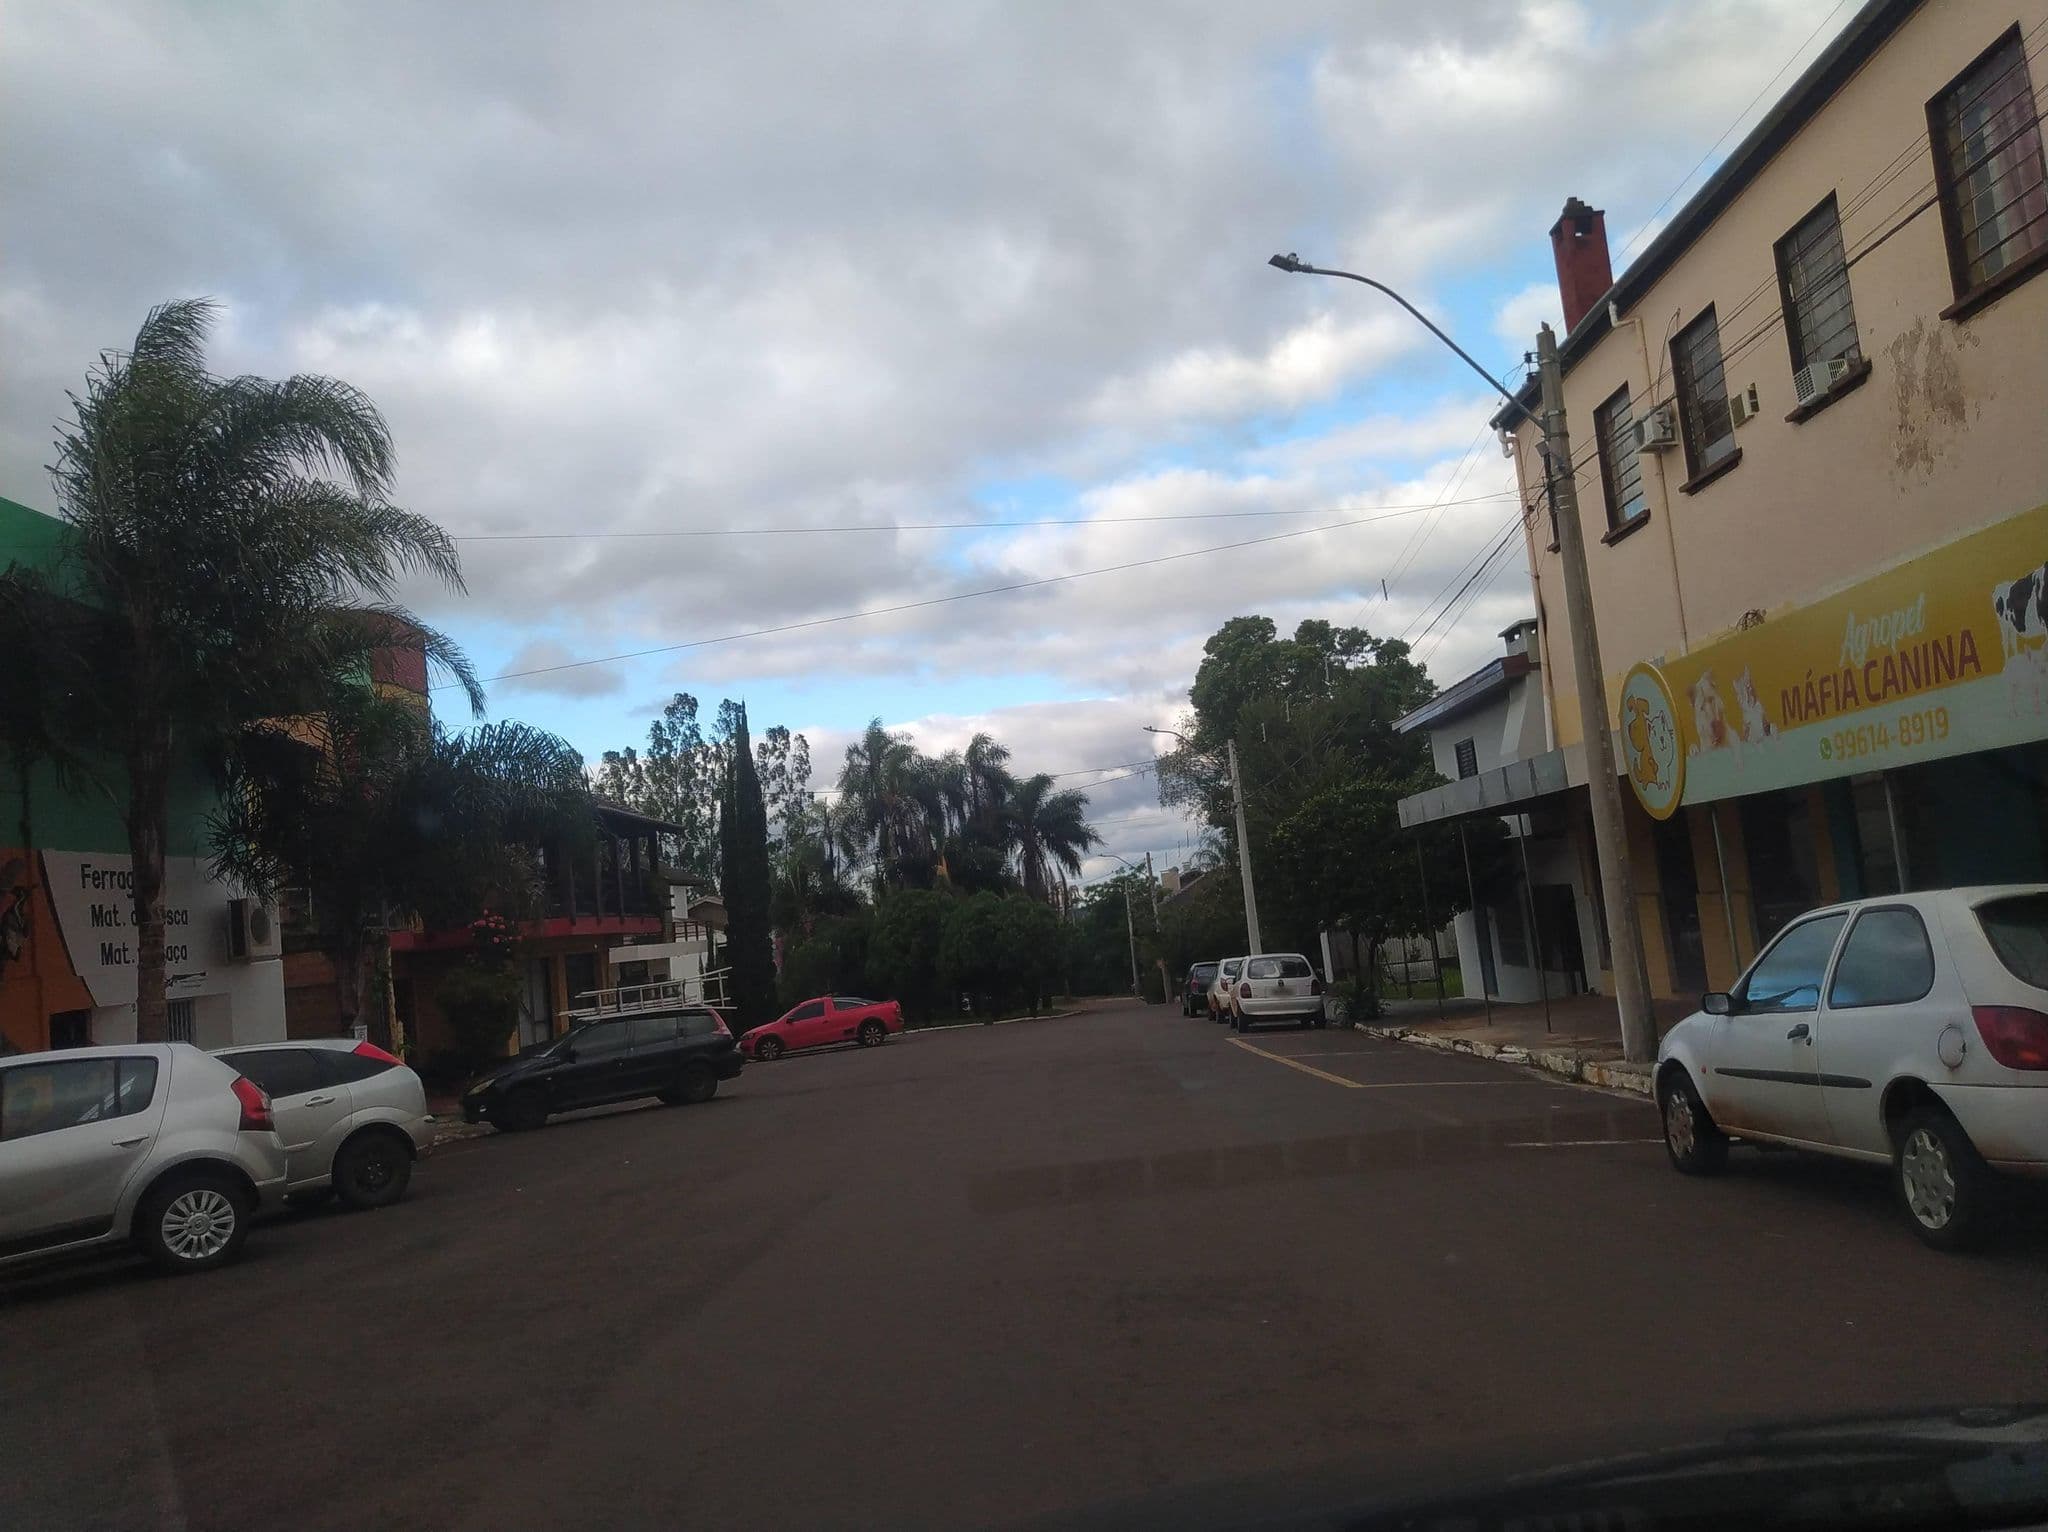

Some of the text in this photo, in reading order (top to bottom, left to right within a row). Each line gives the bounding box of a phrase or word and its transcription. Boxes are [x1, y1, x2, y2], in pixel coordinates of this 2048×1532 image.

[1781, 629, 1982, 725] MÁFIA CANINA
[1832, 706, 1950, 760] 99614-8919
[80, 863, 136, 899] Ferrag
[90, 903, 126, 928] Mat.
[100, 942, 188, 966] Mat. aça
